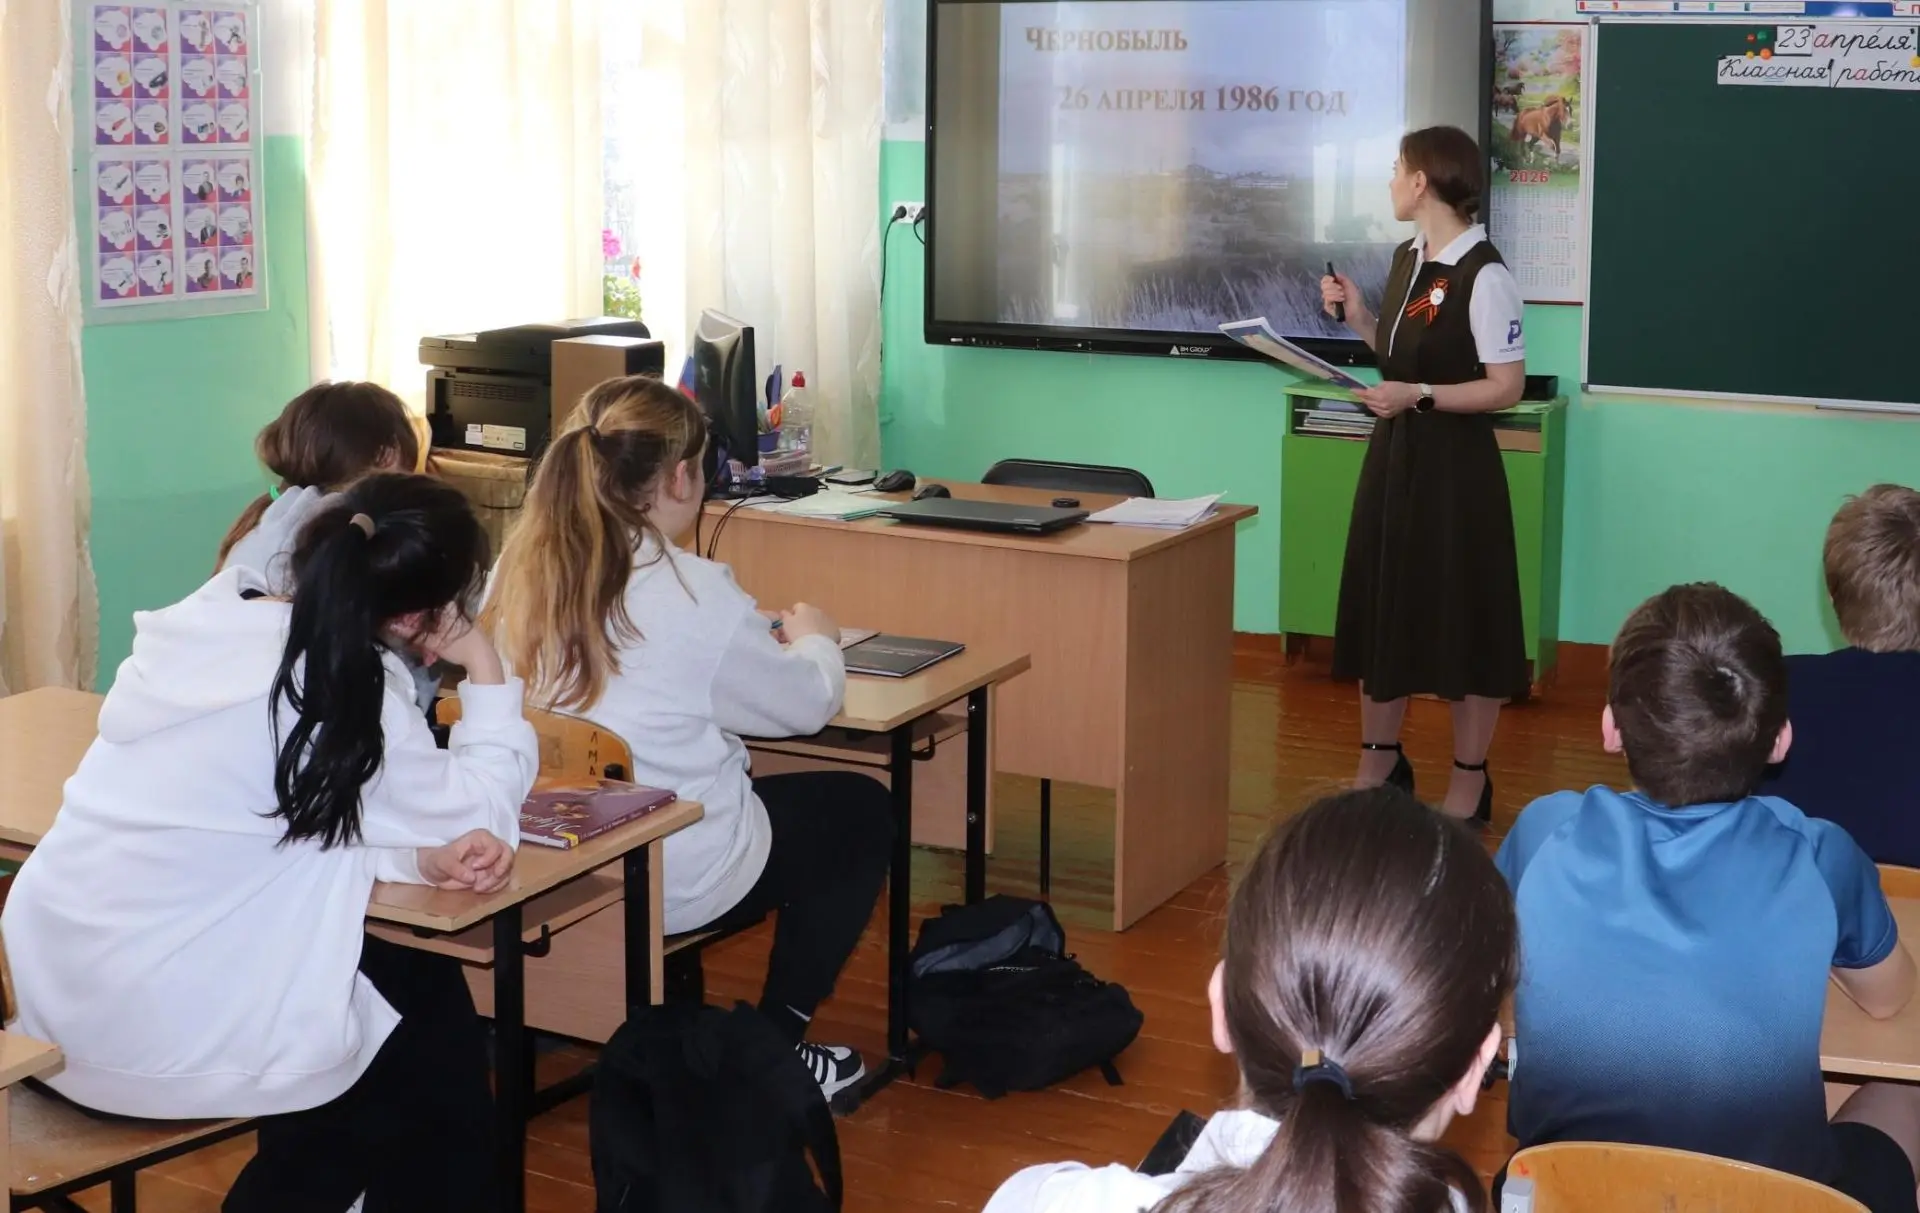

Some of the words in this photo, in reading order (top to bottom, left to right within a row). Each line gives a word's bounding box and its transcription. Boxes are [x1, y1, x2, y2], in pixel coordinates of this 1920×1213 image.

[1025, 26, 1188, 51] ЧЕРНОБЫЛЬ
[1778, 28, 1811, 48] 23
[1719, 58, 1828, 80] Классная
[1059, 86, 1090, 110] 26
[1096, 89, 1206, 111] АПРЕЛЯ
[1215, 86, 1279, 112] 1986
[1288, 90, 1347, 116] ГОД
[1510, 170, 1549, 183] 2026
